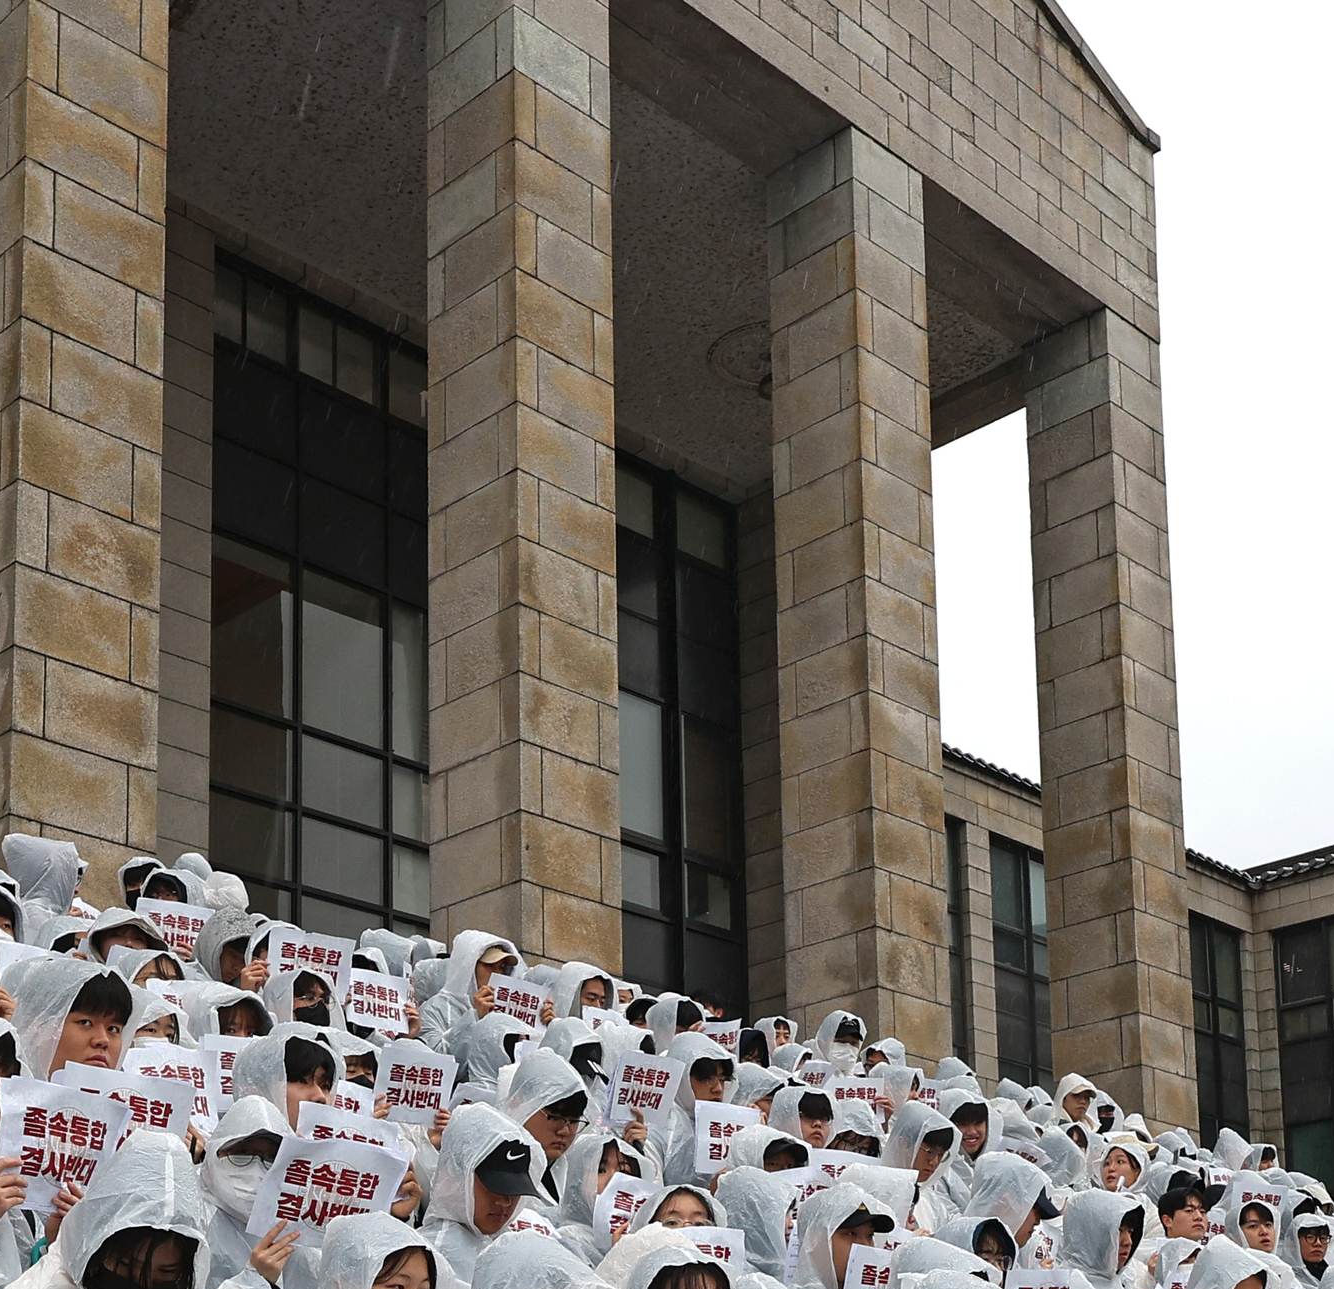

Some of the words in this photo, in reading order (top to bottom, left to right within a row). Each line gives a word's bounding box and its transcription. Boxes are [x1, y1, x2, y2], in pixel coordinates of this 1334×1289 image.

[280, 941, 343, 967] 졸속통합
[353, 979, 399, 1004] 졸속통합
[496, 986, 540, 1010] 졸속통합
[352, 998, 402, 1021] 결사반대
[389, 1062, 444, 1087] 졸속통합
[621, 1065, 670, 1089] 졸속통합
[385, 1086, 441, 1110] 결사반대
[617, 1086, 664, 1110] 결사반대
[23, 1106, 108, 1152] 졸속통합
[19, 1146, 97, 1187] 결사반대
[283, 1158, 381, 1200] 졸속통합
